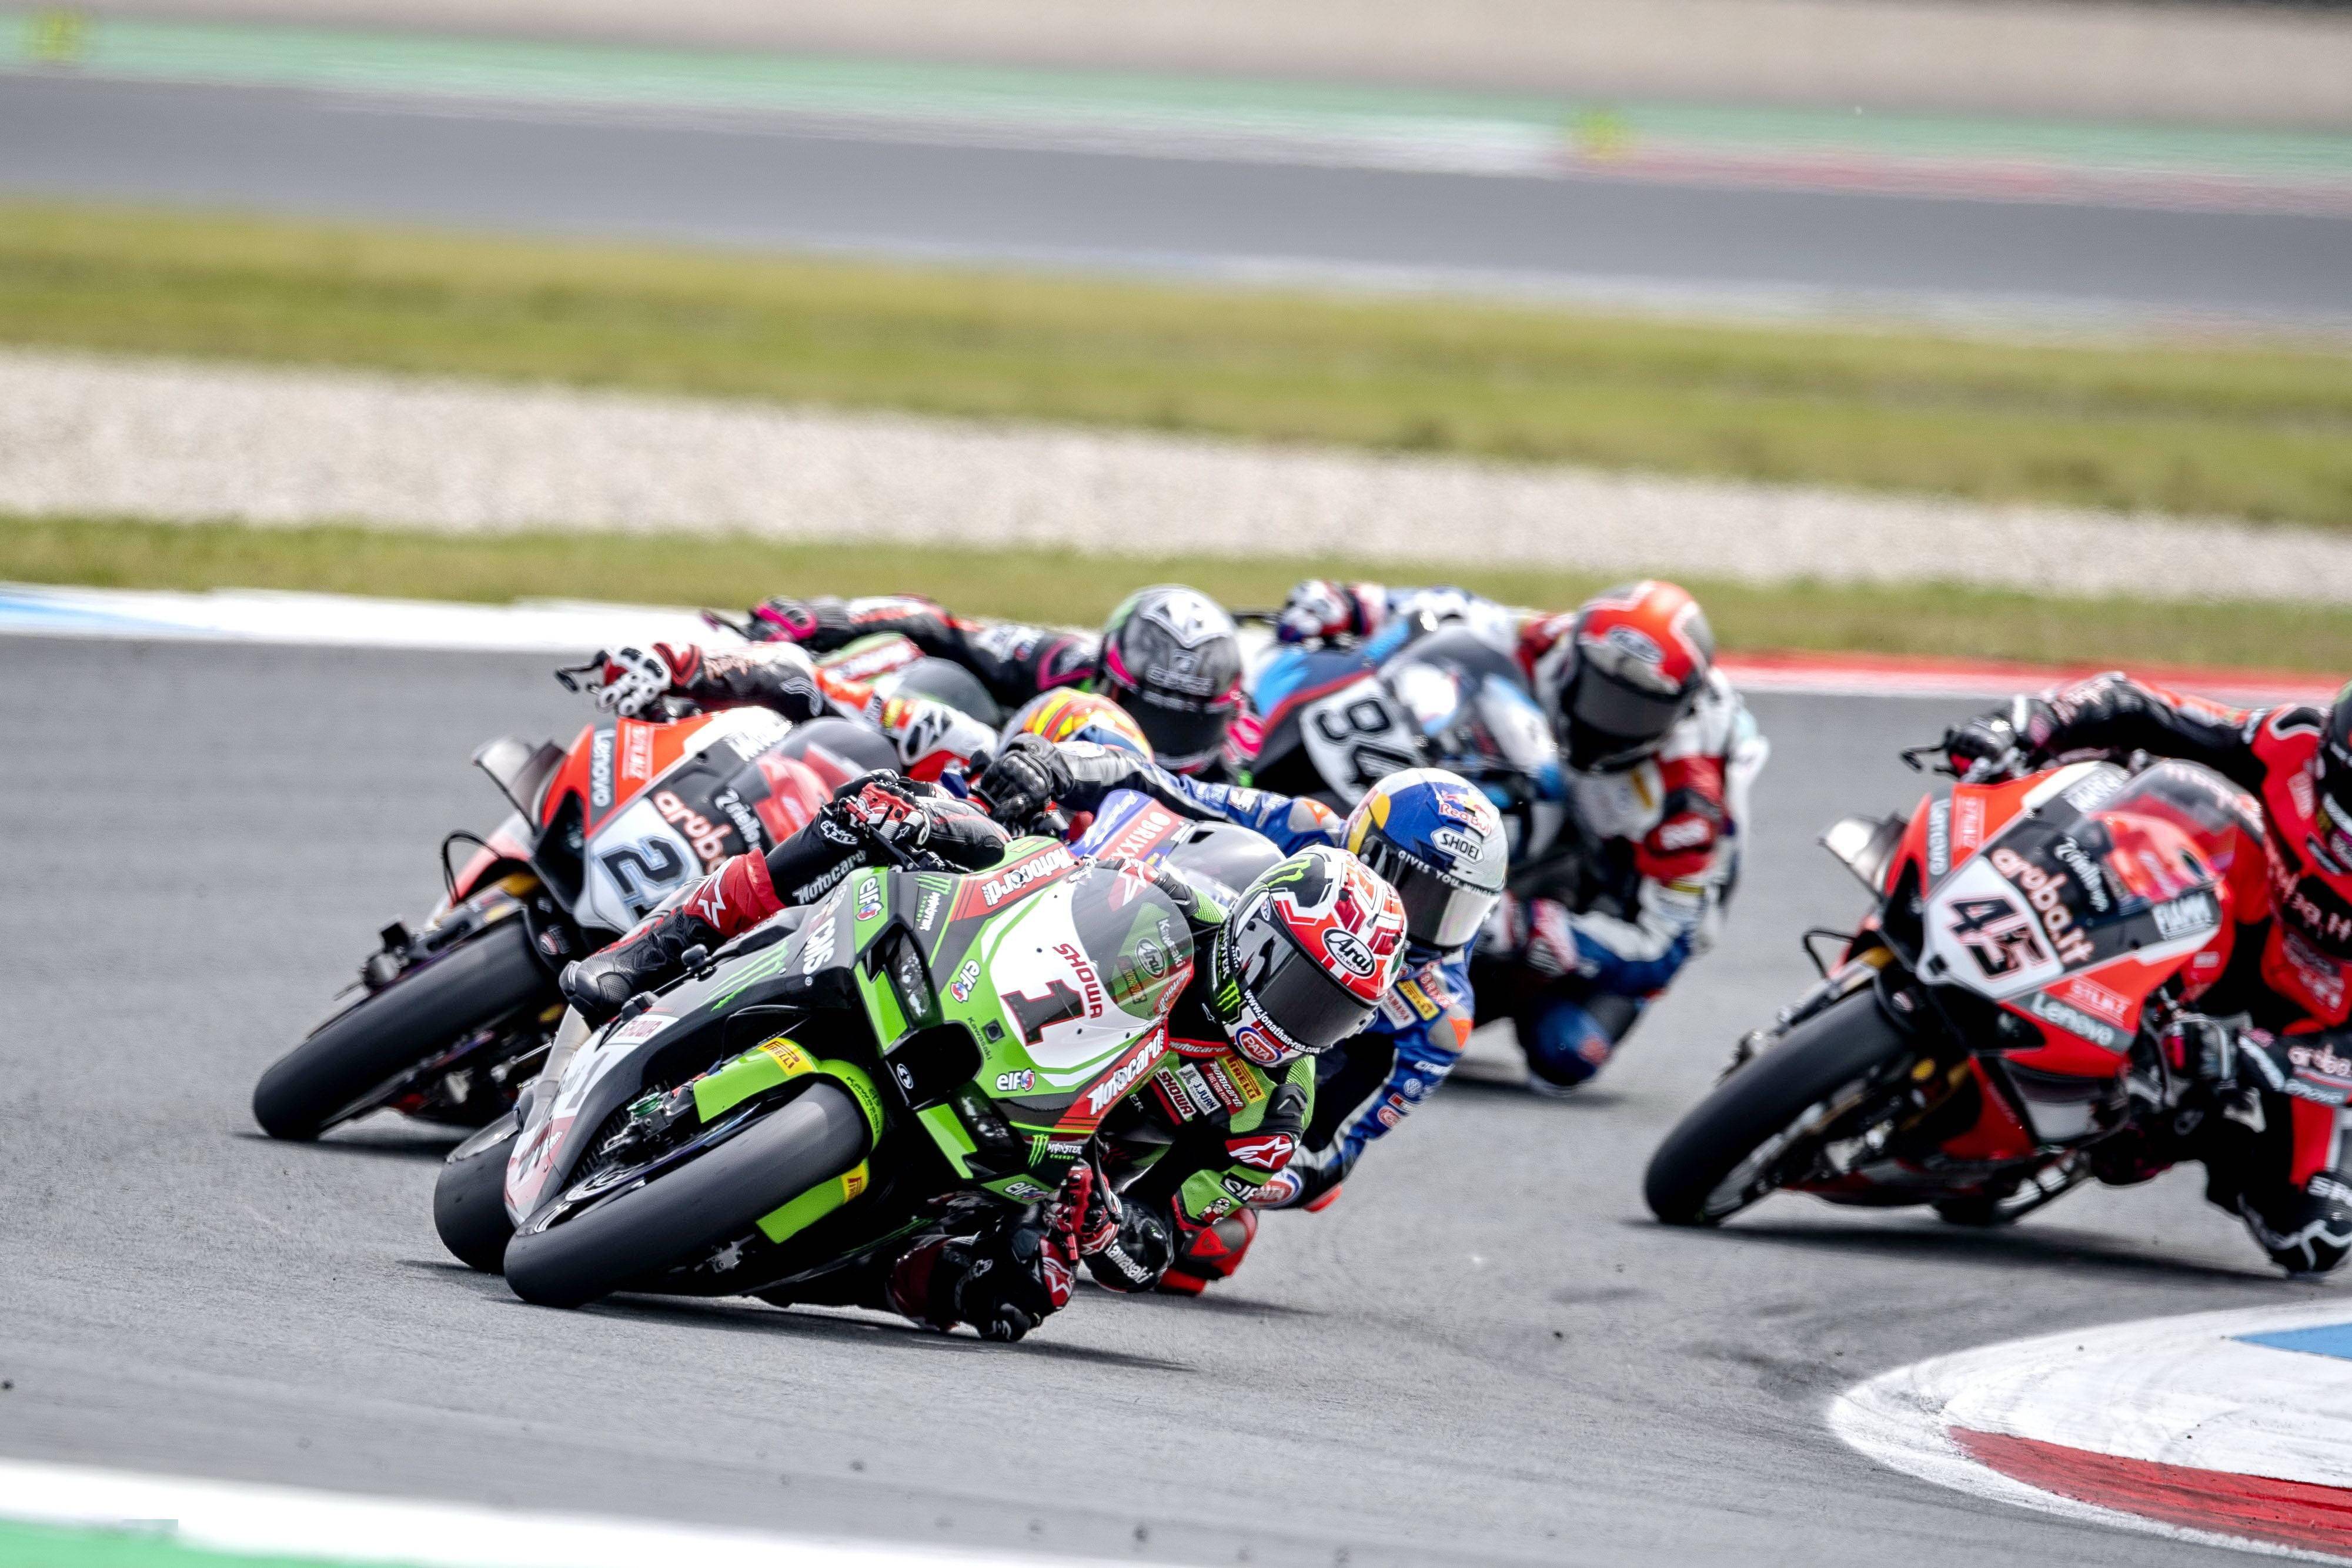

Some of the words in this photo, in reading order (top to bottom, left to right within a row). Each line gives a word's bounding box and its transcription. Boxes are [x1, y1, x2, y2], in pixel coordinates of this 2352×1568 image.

[592, 729, 616, 807] Lenovo
[1440, 833, 1480, 860] SHOEI
[792, 850, 867, 904] Motocard
[1398, 850, 1431, 874] GIVES
[1436, 870, 1460, 886] YOU
[858, 877, 880, 905] elf
[1325, 938, 1373, 971] Arai
[1950, 897, 2051, 980] 45
[959, 959, 981, 992] elf
[1052, 943, 1103, 1019] SHOWA
[1000, 979, 1085, 1047] 1
[1244, 989, 1321, 1054] www.jonathan-rea.com
[764, 1041, 800, 1069] PIRELLI
[967, 1017, 993, 1061] Kawasaki
[1242, 1035, 1271, 1060] PATA
[996, 1071, 1021, 1091] elf
[1087, 1028, 1162, 1115] Motocard
[1157, 1071, 1195, 1115] SHOWA
[1194, 1082, 1217, 1109] J.JUAN
[1047, 1142, 1083, 1155] MONSTER
[1004, 1182, 1040, 1196] elf
[1224, 1178, 1259, 1201] elf
